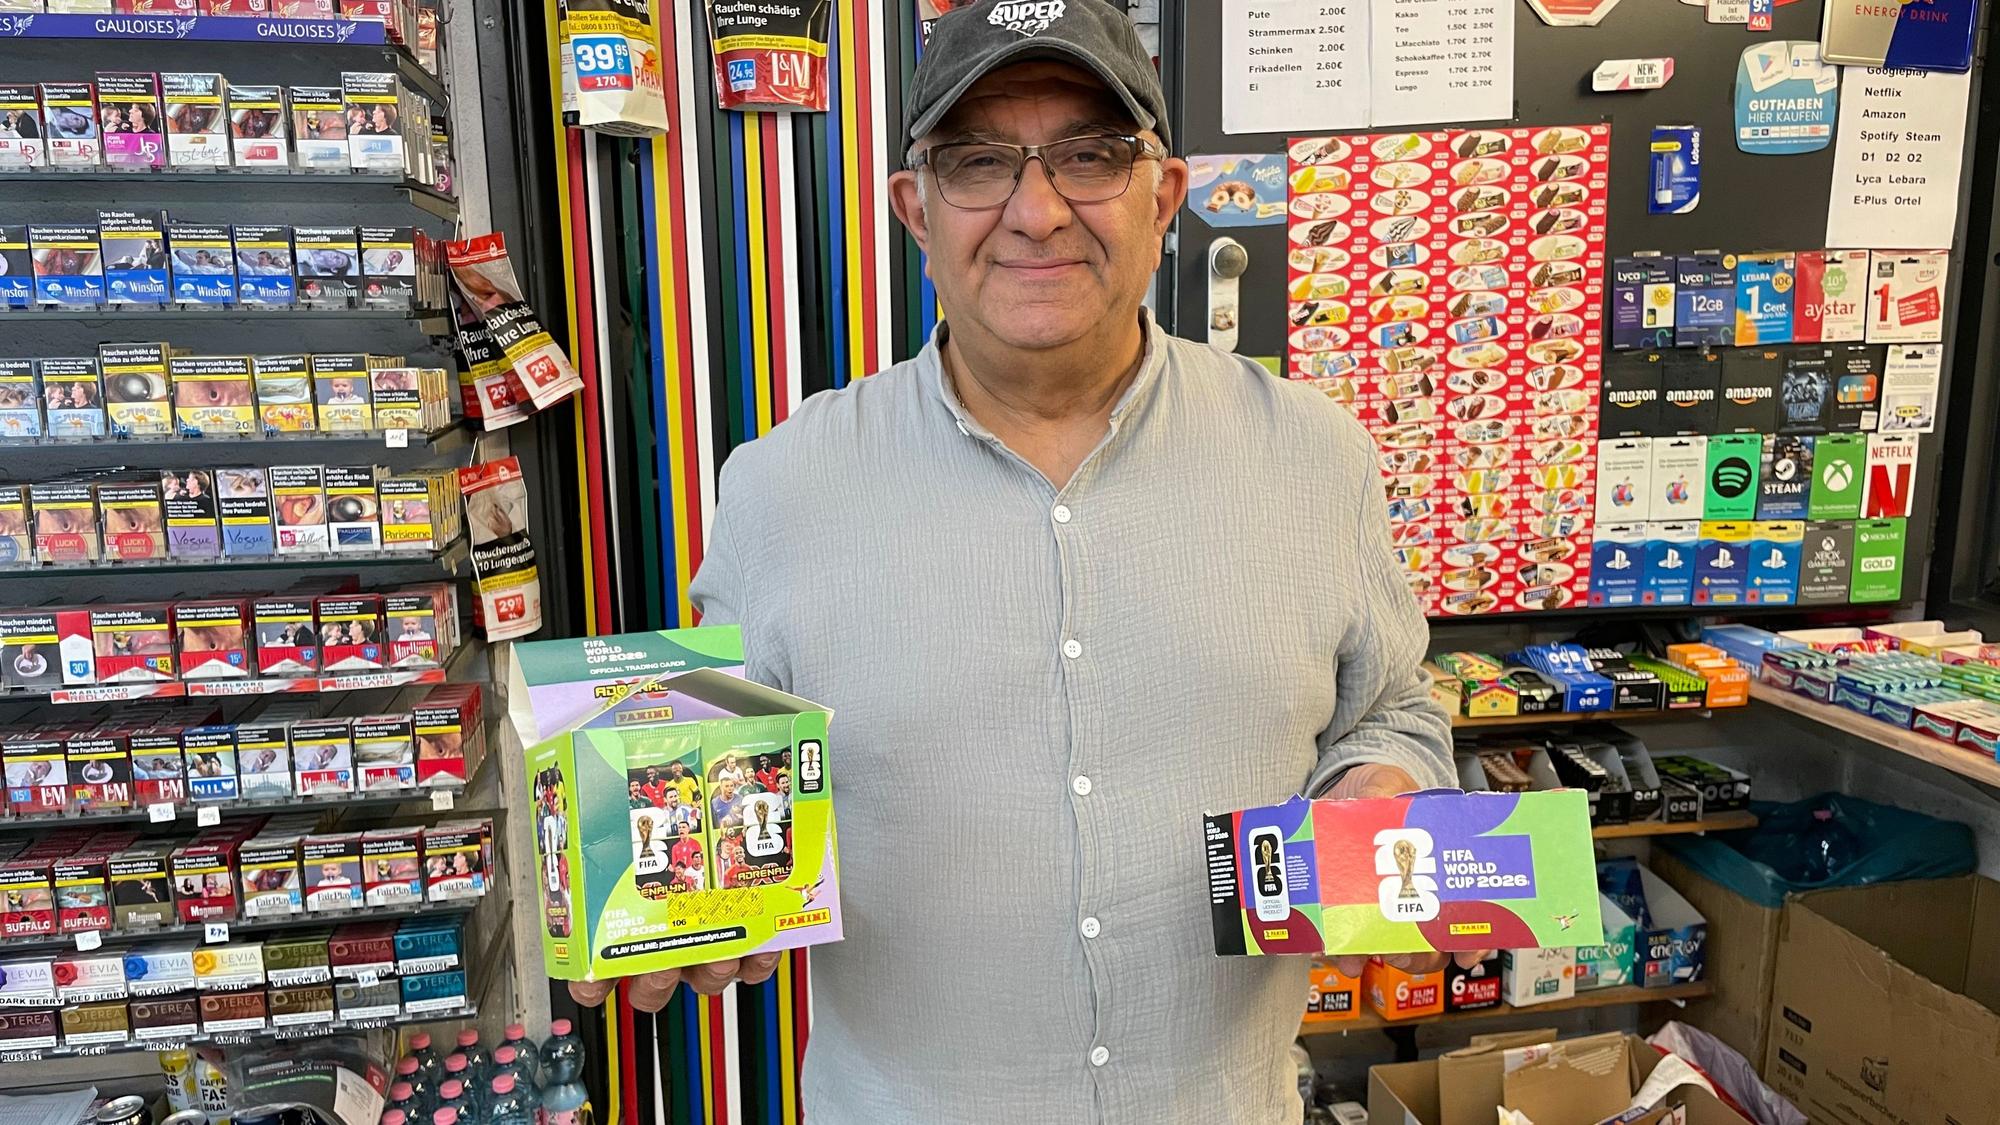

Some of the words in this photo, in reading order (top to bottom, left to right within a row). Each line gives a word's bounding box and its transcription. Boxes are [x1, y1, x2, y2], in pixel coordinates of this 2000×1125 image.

[715, 3, 756, 15] Rauchen
[759, 4, 801, 17] schädigt
[988, 1, 1066, 25] SUPER
[1248, 10, 1270, 20] Pute
[1320, 7, 1346, 16] 2.00€
[1856, 5, 1906, 18] ENERGY
[1910, 11, 1949, 22] DRINK
[736, 15, 768, 27] Lunge
[1719, 14, 1744, 22] tödlich
[96, 19, 174, 34] GAULOISES
[257, 23, 335, 38] GAULOISES
[581, 23, 597, 31] 0800
[1006, 18, 1049, 32] OPA
[1395, 26, 1409, 34] Tee
[1473, 22, 1493, 30] 2.50€
[1248, 27, 1316, 38] Strammermax
[1318, 26, 1345, 35] 2.50€
[1395, 39, 1440, 48] L.Macchiato
[1447, 38, 1466, 46] 1.70€
[1248, 46, 1293, 56] Schinken
[1319, 44, 1345, 53] 2.00€
[576, 44, 614, 71] 39
[1395, 53, 1445, 62] Schokokaffee
[1448, 52, 1467, 60] 1.70€
[771, 51, 810, 89] L&M
[1249, 63, 1302, 74] Frikadellen
[1316, 62, 1342, 72] 2.60€
[1395, 69, 1428, 78] Espresso
[1472, 65, 1492, 73] 2.70€
[1249, 83, 1258, 92] Ei
[1316, 80, 1342, 89] 2.30€
[1395, 84, 1418, 92] Lungo
[1449, 81, 1468, 89] 1.70€
[1472, 79, 1492, 87] 2.70€
[1864, 87, 1902, 97] Netflix
[1749, 98, 1823, 112] GUTHABEN
[1748, 112, 1772, 124] HIER
[1776, 110, 1823, 122] KAUFEN!
[1862, 109, 1906, 119] Amazon
[1860, 132, 1898, 142] Spotify
[1906, 132, 1941, 142] Steam
[1690, 132, 1700, 165] Labello
[1862, 152, 1875, 162] D1
[1886, 153, 1900, 162] D2
[1907, 153, 1922, 162] O2
[1856, 174, 1881, 185] Lyca
[1889, 175, 1926, 184] Lebara
[1854, 196, 1887, 206] E-Plus
[1894, 196, 1921, 206] Ortel
[1618, 272, 1640, 282] Lyca
[1680, 274, 1704, 284] Lyca
[1742, 273, 1770, 282] LEBARA
[65, 286, 100, 298] Winston
[130, 281, 164, 293] Winston
[198, 286, 232, 298] Winston
[258, 286, 290, 297] Winston
[324, 286, 358, 297] Winston
[382, 284, 413, 296] Winston
[1692, 296, 1724, 312] 12GB
[1762, 303, 1786, 314] Cent
[1804, 300, 1856, 322] aystar
[1608, 388, 1656, 402] amazon
[1666, 388, 1714, 402] amazon
[1726, 386, 1772, 399] amazon
[116, 406, 163, 419] CAMEL
[192, 408, 240, 420] CAMEL
[266, 408, 308, 418] CAMEL
[1872, 446, 1912, 460] NETFLIX
[1764, 483, 1802, 494] STEAM
[172, 529, 213, 550] Vogue
[384, 530, 431, 540] Parisienne
[54, 538, 78, 548] LUCKY
[122, 538, 146, 547] LUCKY
[1864, 558, 1893, 569] GOLD
[584, 640, 606, 649] FIFA
[584, 647, 622, 656] WORLD
[1549, 650, 1583, 664] OCB
[586, 654, 608, 664] CUP
[590, 666, 624, 675] OFFICIAL
[625, 663, 659, 672] TRADING
[660, 660, 686, 669] CARDS
[1670, 678, 1706, 693] GIZEH
[1579, 696, 1600, 706] OCB
[618, 710, 670, 722] PANINI
[103, 782, 128, 802] L&M
[159, 779, 184, 800] L&M
[194, 783, 221, 794] NIL
[41, 787, 66, 806] L&M
[1634, 790, 1658, 802] OCB
[1670, 801, 1698, 813] OCB
[757, 841, 775, 851] FIFA
[1443, 850, 1474, 862] FIFA
[639, 859, 658, 868] FIFA
[1444, 862, 1496, 876] WORLD
[1446, 876, 1474, 888] CUP
[1477, 875, 1528, 888] 2026
[1264, 884, 1277, 892] FIFA
[605, 910, 628, 920] FIFA
[1397, 904, 1424, 914] FIFA
[64, 916, 108, 928] BUFFALO
[605, 917, 644, 930] WORLD
[672, 918, 686, 926] 106
[778, 910, 830, 928] PANINI
[6, 920, 50, 933] BUFFALO
[606, 928, 628, 938] CUP
[630, 924, 668, 936] 2026
[1461, 924, 1489, 932] PANINI
[416, 934, 454, 944] TEREA
[350, 942, 390, 952] TEREA
[610, 946, 630, 956] PLAY
[630, 941, 658, 952] ONLINE:
[152, 958, 189, 970] LEVIA
[220, 952, 257, 964] LEVIA
[10, 968, 46, 980] LEVIA
[82, 964, 119, 974] LEVIA
[422, 975, 461, 986] TEREA
[1452, 974, 1466, 996] 6
[94, 991, 128, 1000] BERRY
[290, 990, 329, 1000] TEREA
[1324, 992, 1348, 1002] SLIM
[1396, 981, 1409, 1002] 6
[1412, 988, 1434, 998] SLIM
[30, 998, 63, 1006] BERRY
[1324, 1002, 1348, 1010] FILTER
[152, 1003, 192, 1014] TEREA
[10, 1015, 50, 1026] TEREA
